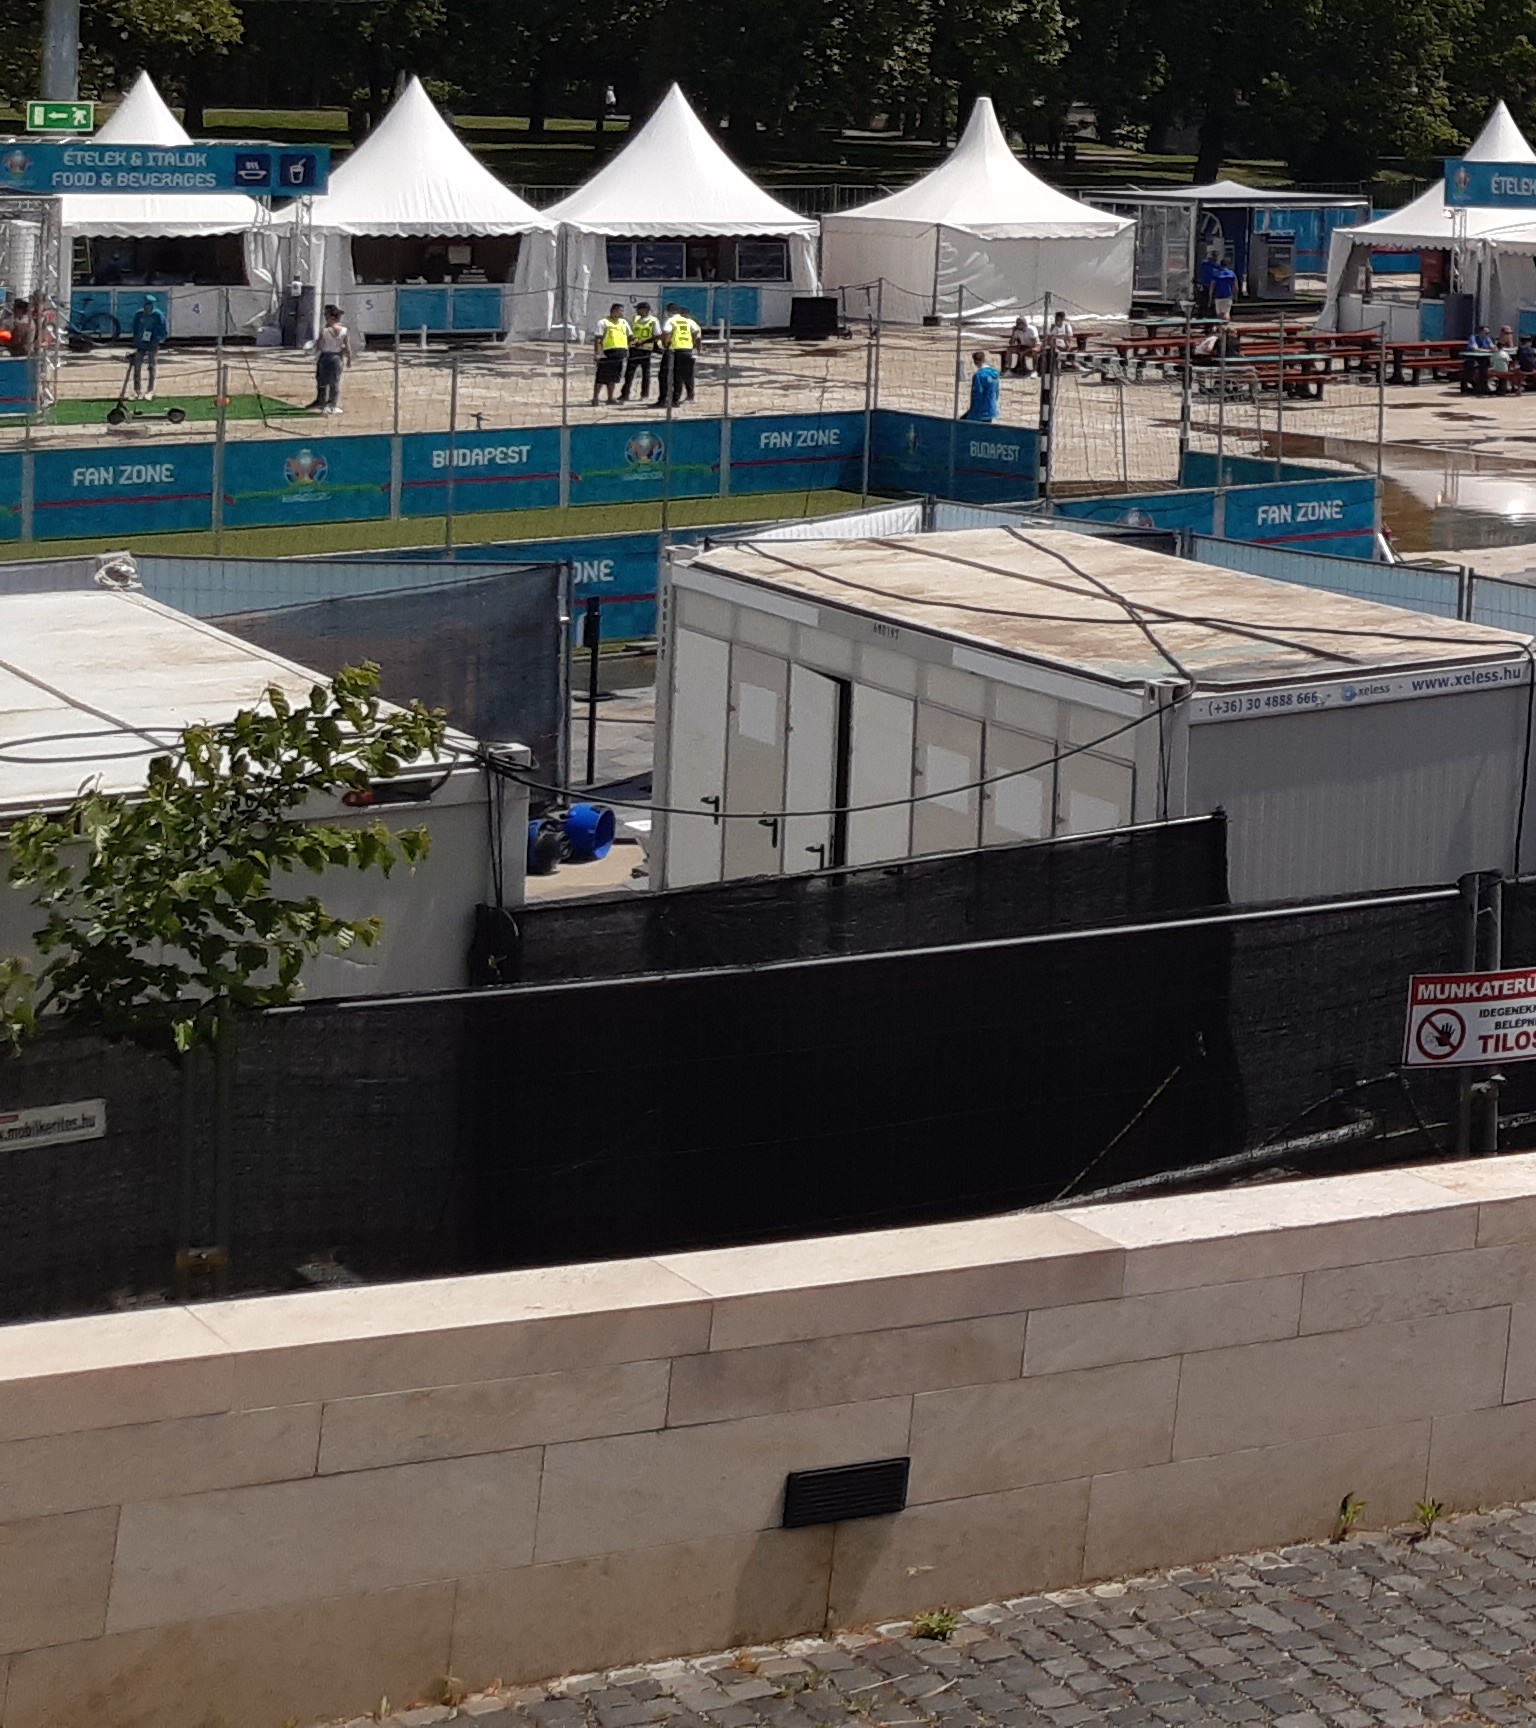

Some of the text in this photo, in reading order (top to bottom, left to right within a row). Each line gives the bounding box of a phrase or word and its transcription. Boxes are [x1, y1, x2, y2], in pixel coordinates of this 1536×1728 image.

[64, 148, 207, 167] ÉTELEK & ITALOK
[52, 172, 217, 188] FOOD & BEVERAGES
[760, 428, 841, 449] FAN ZONE
[432, 445, 531, 469] BUDAPEST
[969, 440, 1021, 462] BUDAPEST
[72, 464, 175, 486] FAN ZONE
[1257, 500, 1344, 526] FAN ZONE
[573, 559, 615, 584] ONE
[1208, 697, 1243, 717] (+36)
[1247, 697, 1261, 711] 30
[1265, 694, 1293, 709] 4888
[1297, 691, 1318, 706] 666
[1412, 666, 1521, 692] www.xeless.hu
